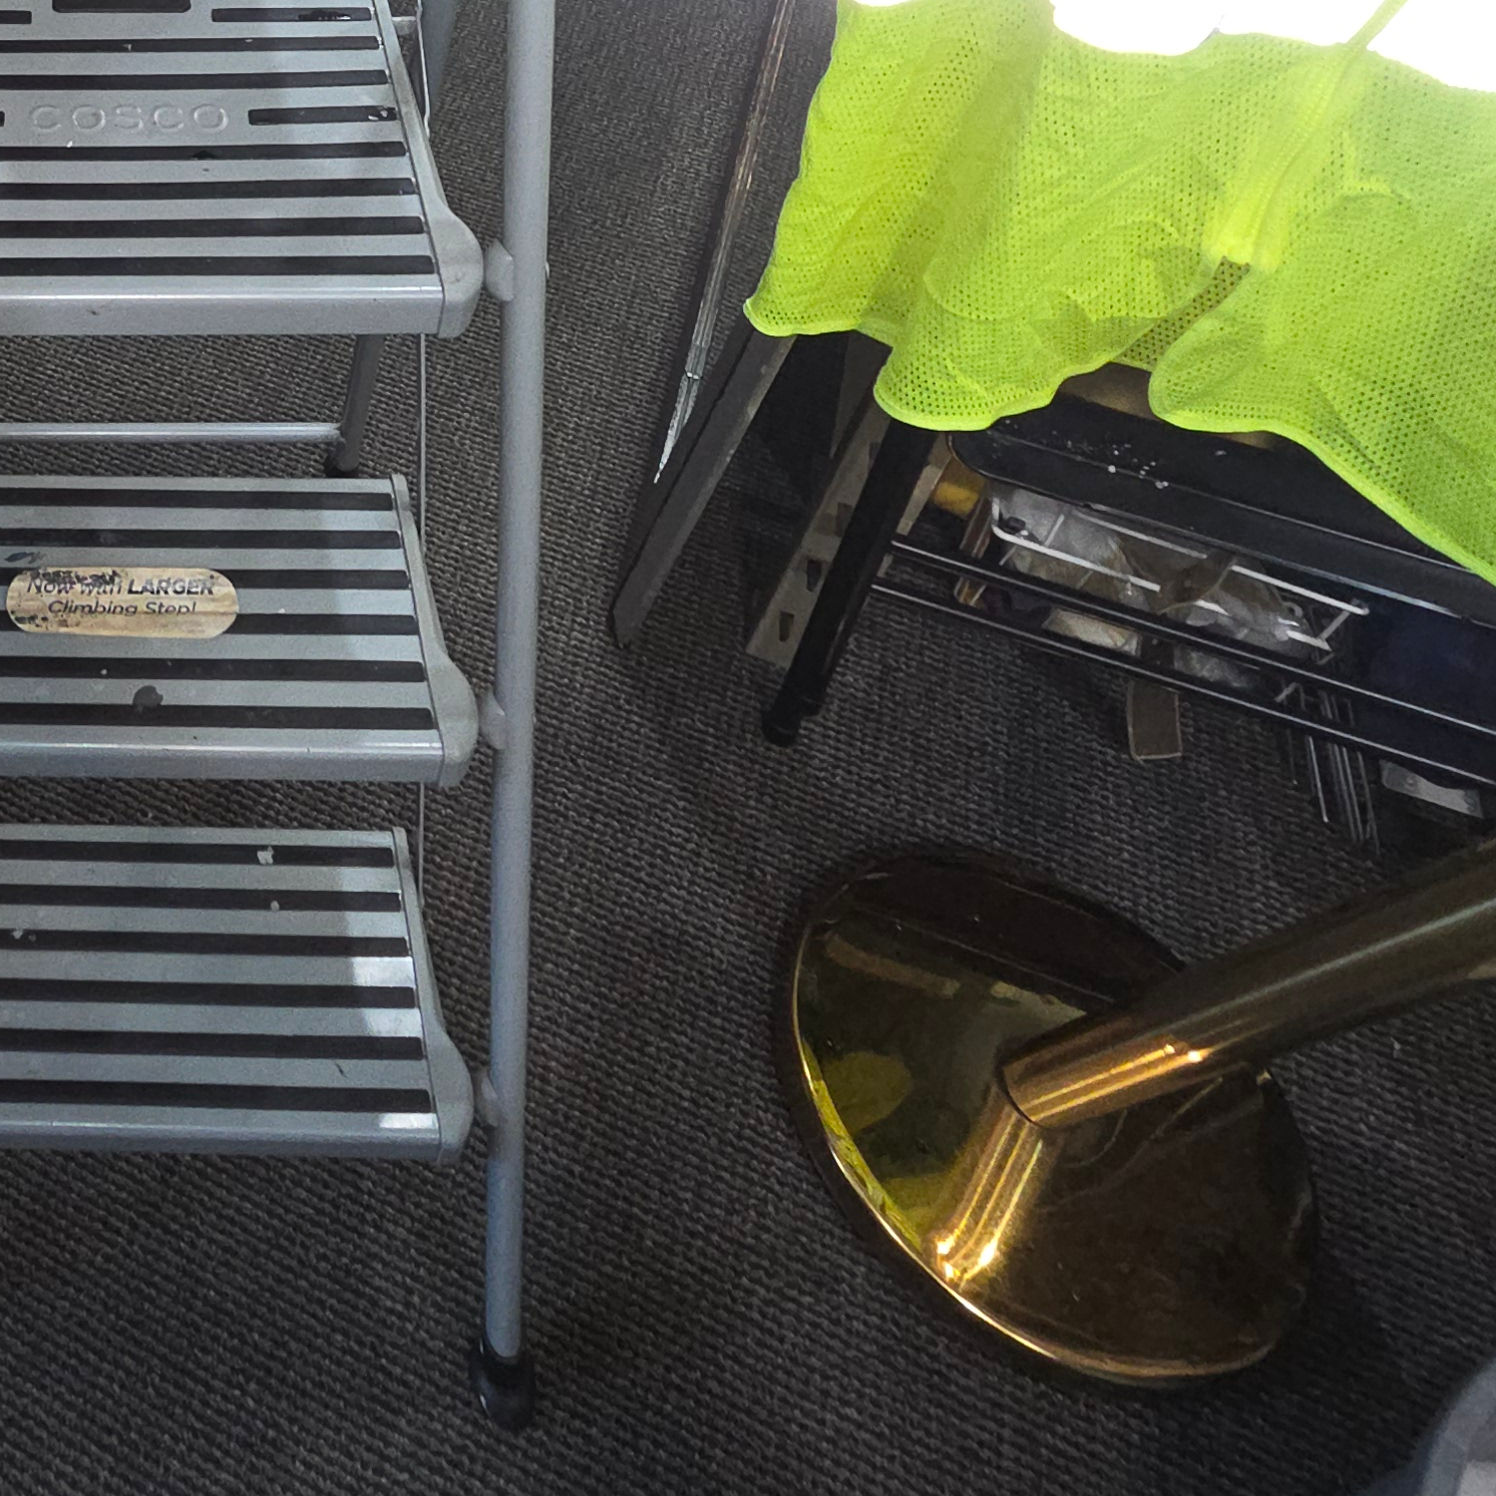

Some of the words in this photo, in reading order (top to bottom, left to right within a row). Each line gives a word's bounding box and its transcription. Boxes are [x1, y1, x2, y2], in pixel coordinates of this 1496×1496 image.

[29, 105, 229, 133] COSCO
[127, 578, 215, 596] LARGER
[48, 600, 137, 616] Climbing
